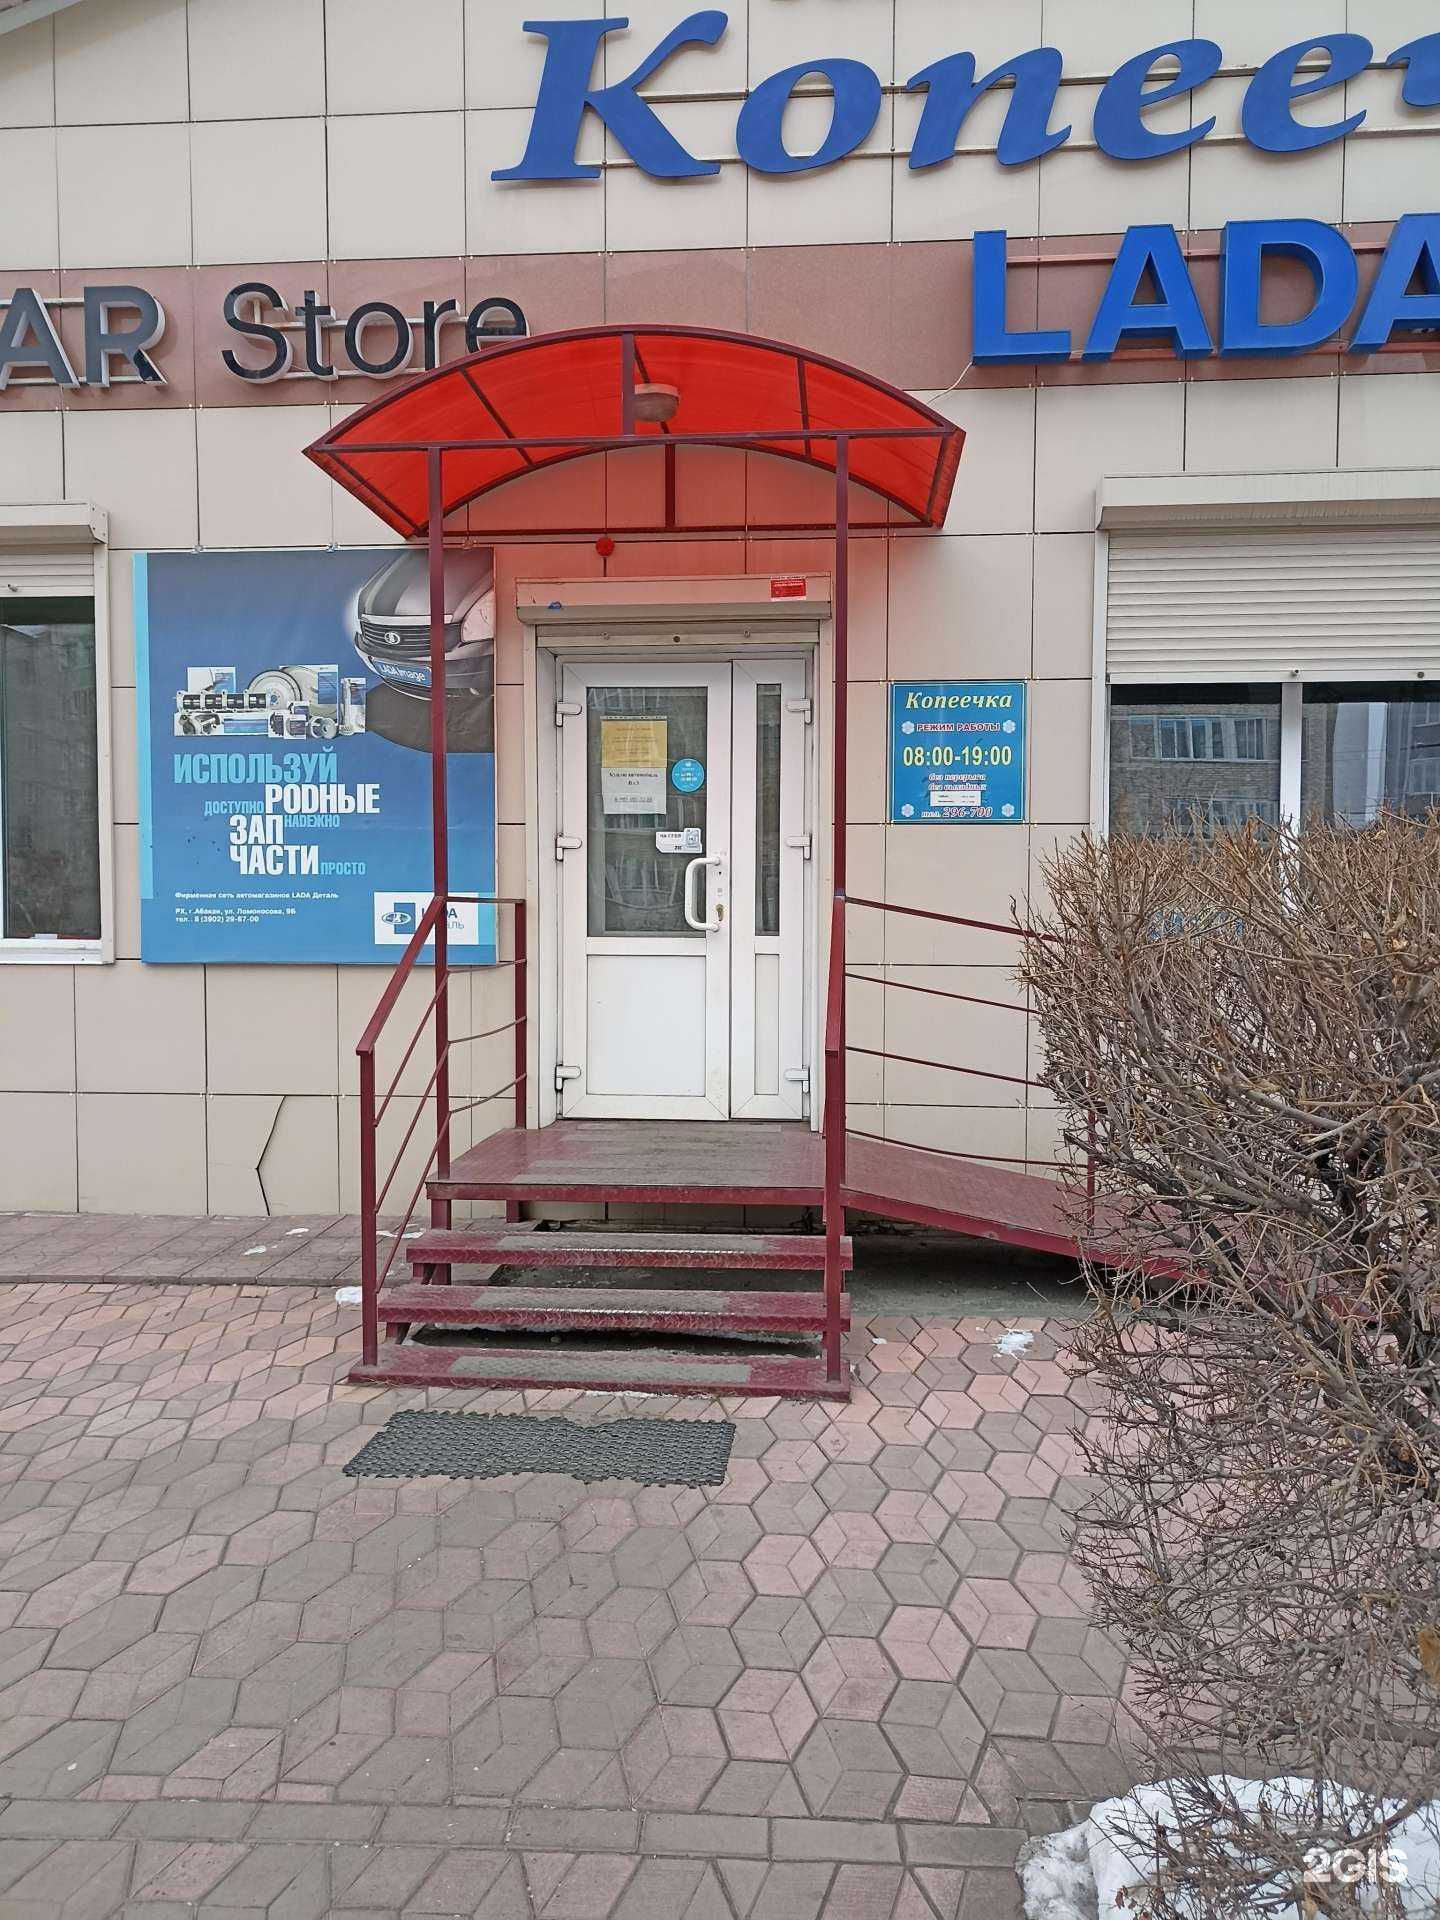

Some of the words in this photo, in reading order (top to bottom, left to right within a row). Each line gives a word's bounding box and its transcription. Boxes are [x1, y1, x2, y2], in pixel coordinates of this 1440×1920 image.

[971, 213, 1440, 365] LADA
[221, 282, 530, 385] Store
[905, 692, 1013, 709] Копеечка
[916, 723, 954, 732] РЕЖИМ
[957, 723, 1000, 731] РАБОТЫ
[174, 746, 337, 784] ИСПОЛЬЗУЙ
[903, 746, 1012, 766] 08:00-19:00
[204, 801, 264, 816] ДОСТУПНО
[943, 806, 993, 818] 296-700
[229, 815, 284, 845] ЗАП
[229, 845, 319, 876] ЧАСТИ
[320, 862, 366, 876] ПРОСТО
[175, 891, 217, 900] Фирменная
[312, 892, 338, 900] Деталь
